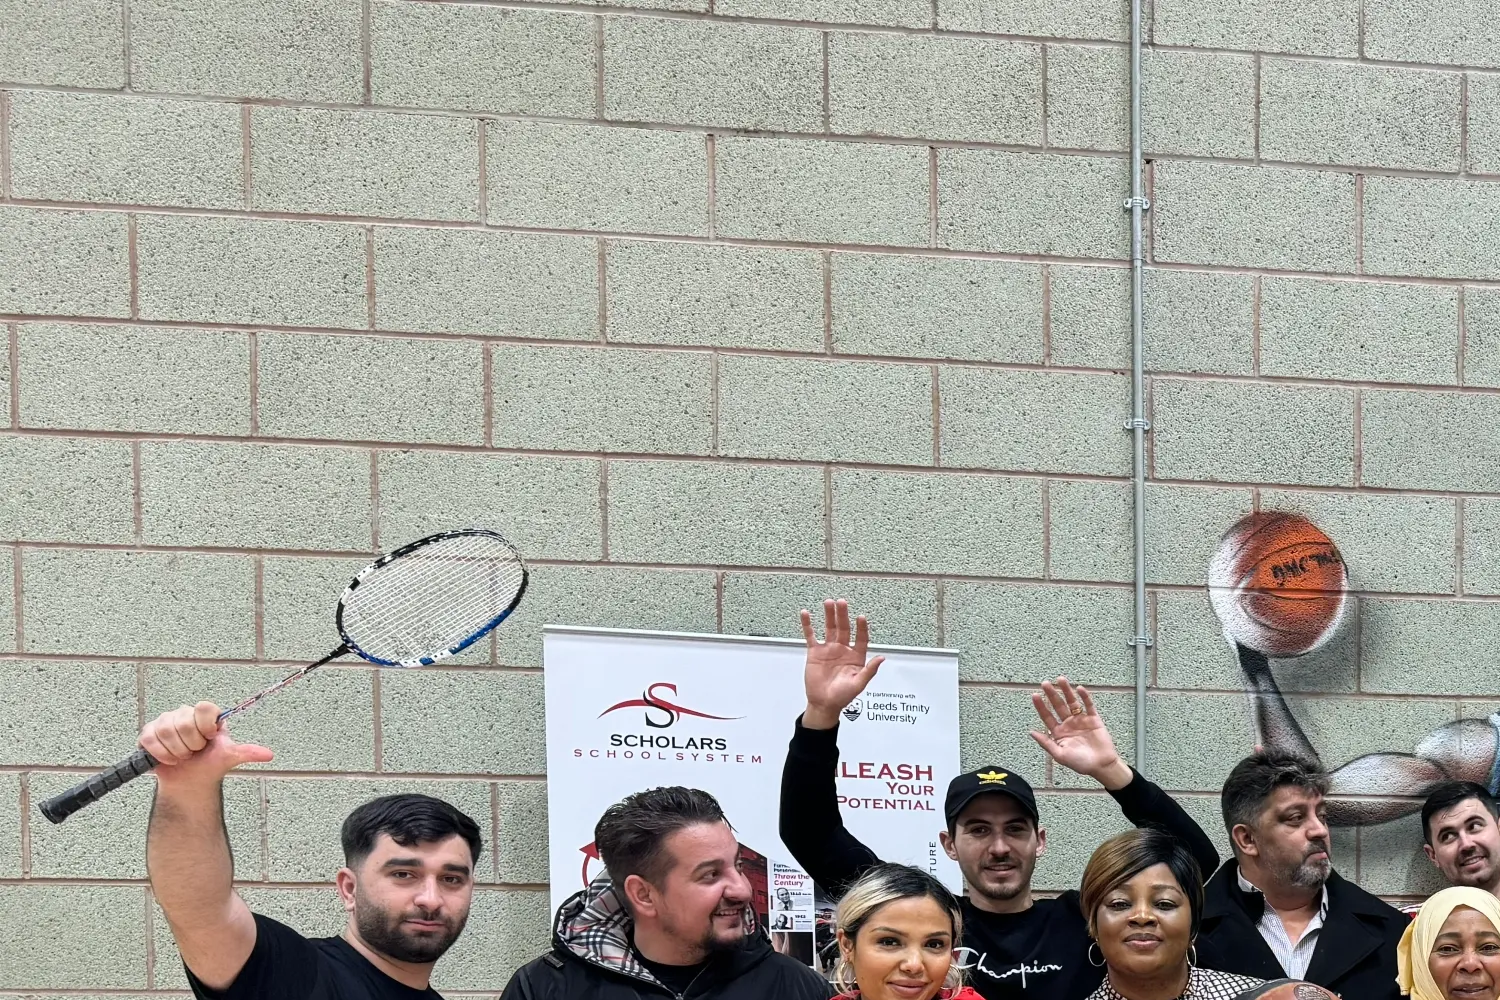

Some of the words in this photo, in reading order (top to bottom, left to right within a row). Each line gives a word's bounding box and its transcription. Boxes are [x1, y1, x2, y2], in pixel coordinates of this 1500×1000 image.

[867, 700, 898, 711] Leeds
[899, 702, 930, 715] Trinity
[867, 711, 917, 725] University
[610, 733, 728, 751] SCHOLARS
[573, 748, 667, 760] SCHOOL
[675, 752, 763, 764] SYSTEM
[835, 761, 933, 782] LEASH
[952, 946, 1063, 989] Champion
